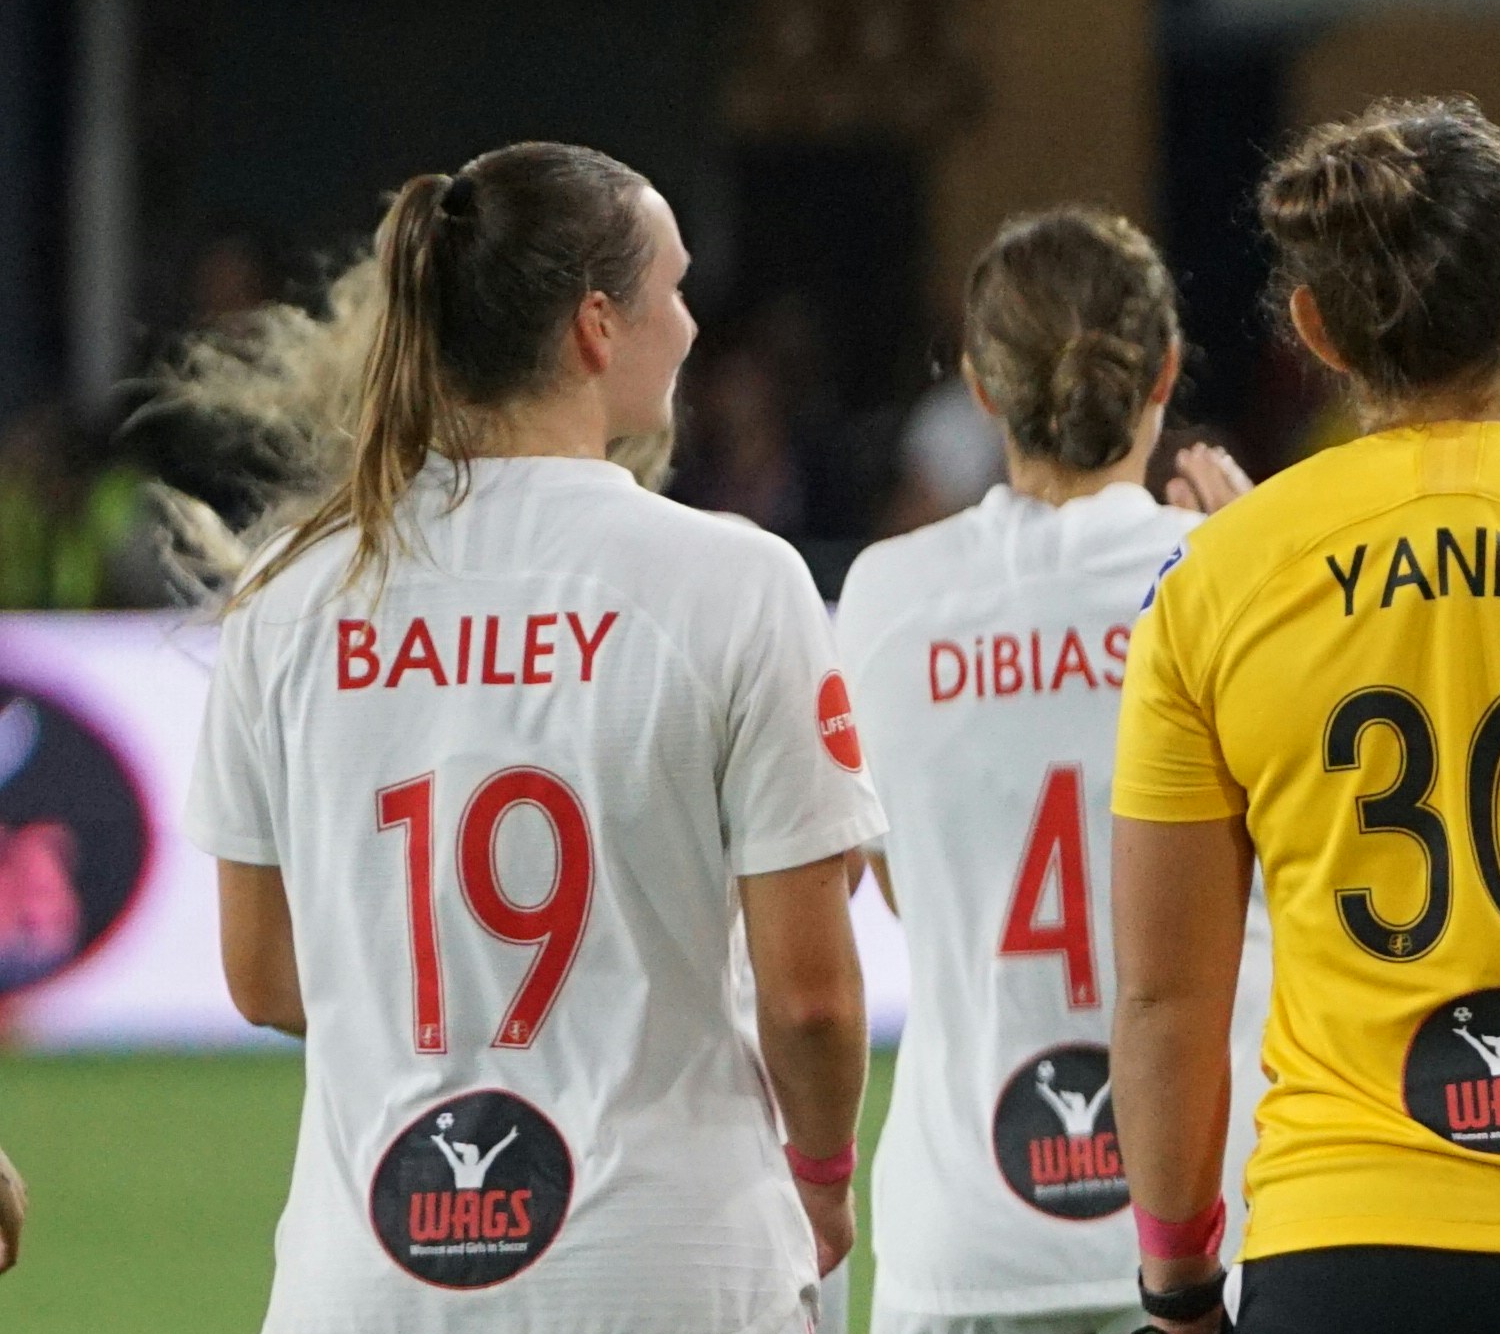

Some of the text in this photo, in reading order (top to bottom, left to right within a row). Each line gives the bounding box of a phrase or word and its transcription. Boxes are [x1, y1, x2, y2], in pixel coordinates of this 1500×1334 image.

[337, 611, 619, 691] BAILEY
[929, 624, 1132, 703] DiBIAS
[375, 765, 596, 1055] 19
[1000, 761, 1102, 1010] 4
[1029, 1132, 1125, 1185] WAG
[409, 1189, 532, 1242] WAGS
